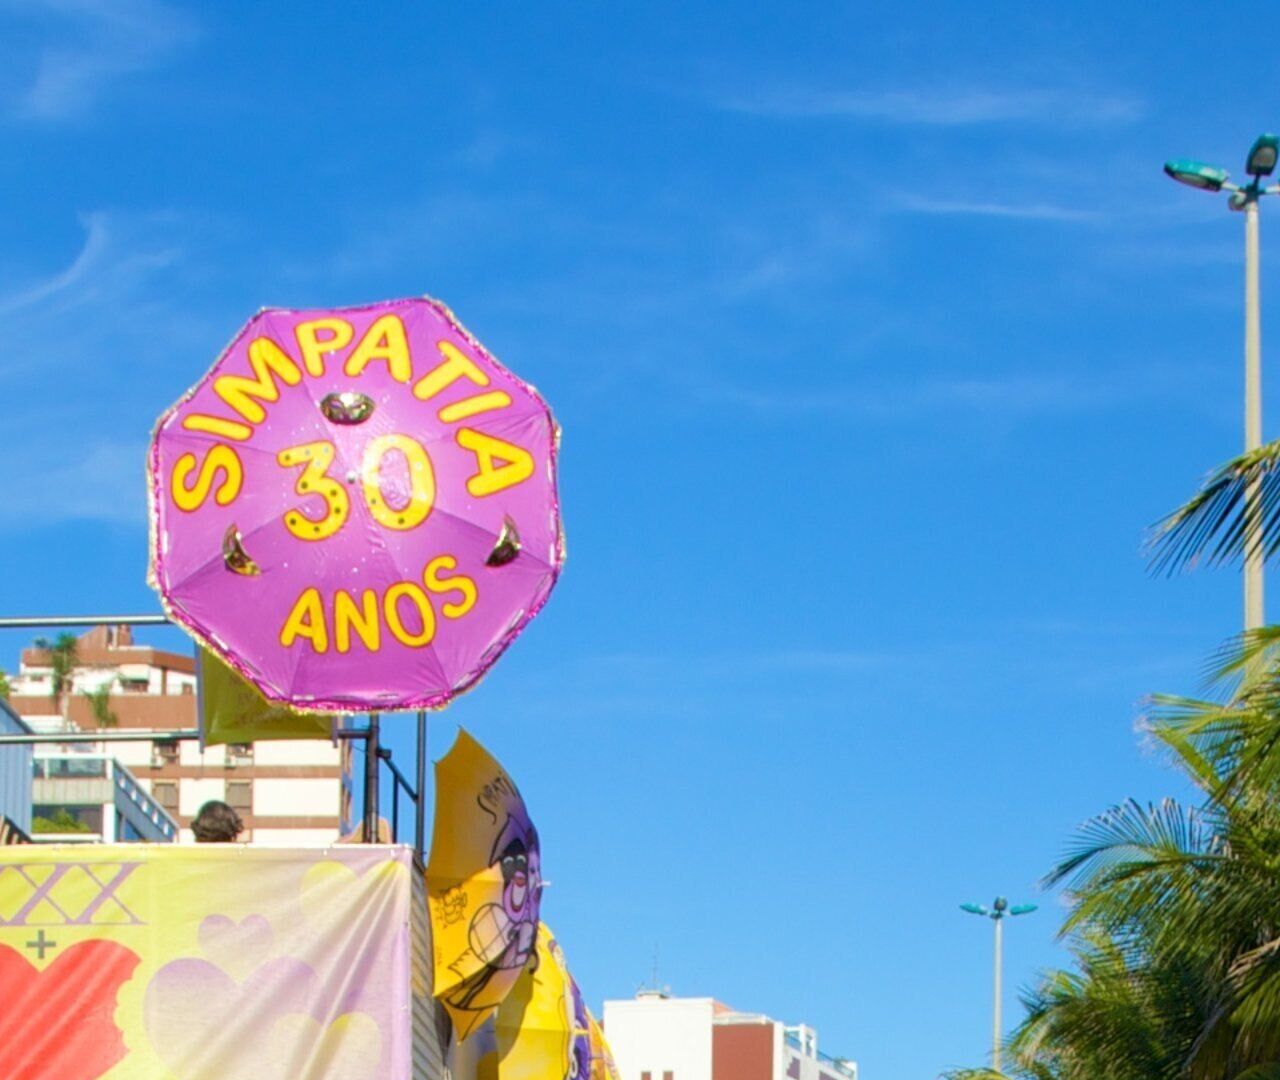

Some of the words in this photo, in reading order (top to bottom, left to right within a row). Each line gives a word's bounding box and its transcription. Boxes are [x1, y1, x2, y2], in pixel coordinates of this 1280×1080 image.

[171, 313, 535, 513] SIMPATIA
[276, 434, 437, 541] 30
[279, 555, 479, 654] ANOS
